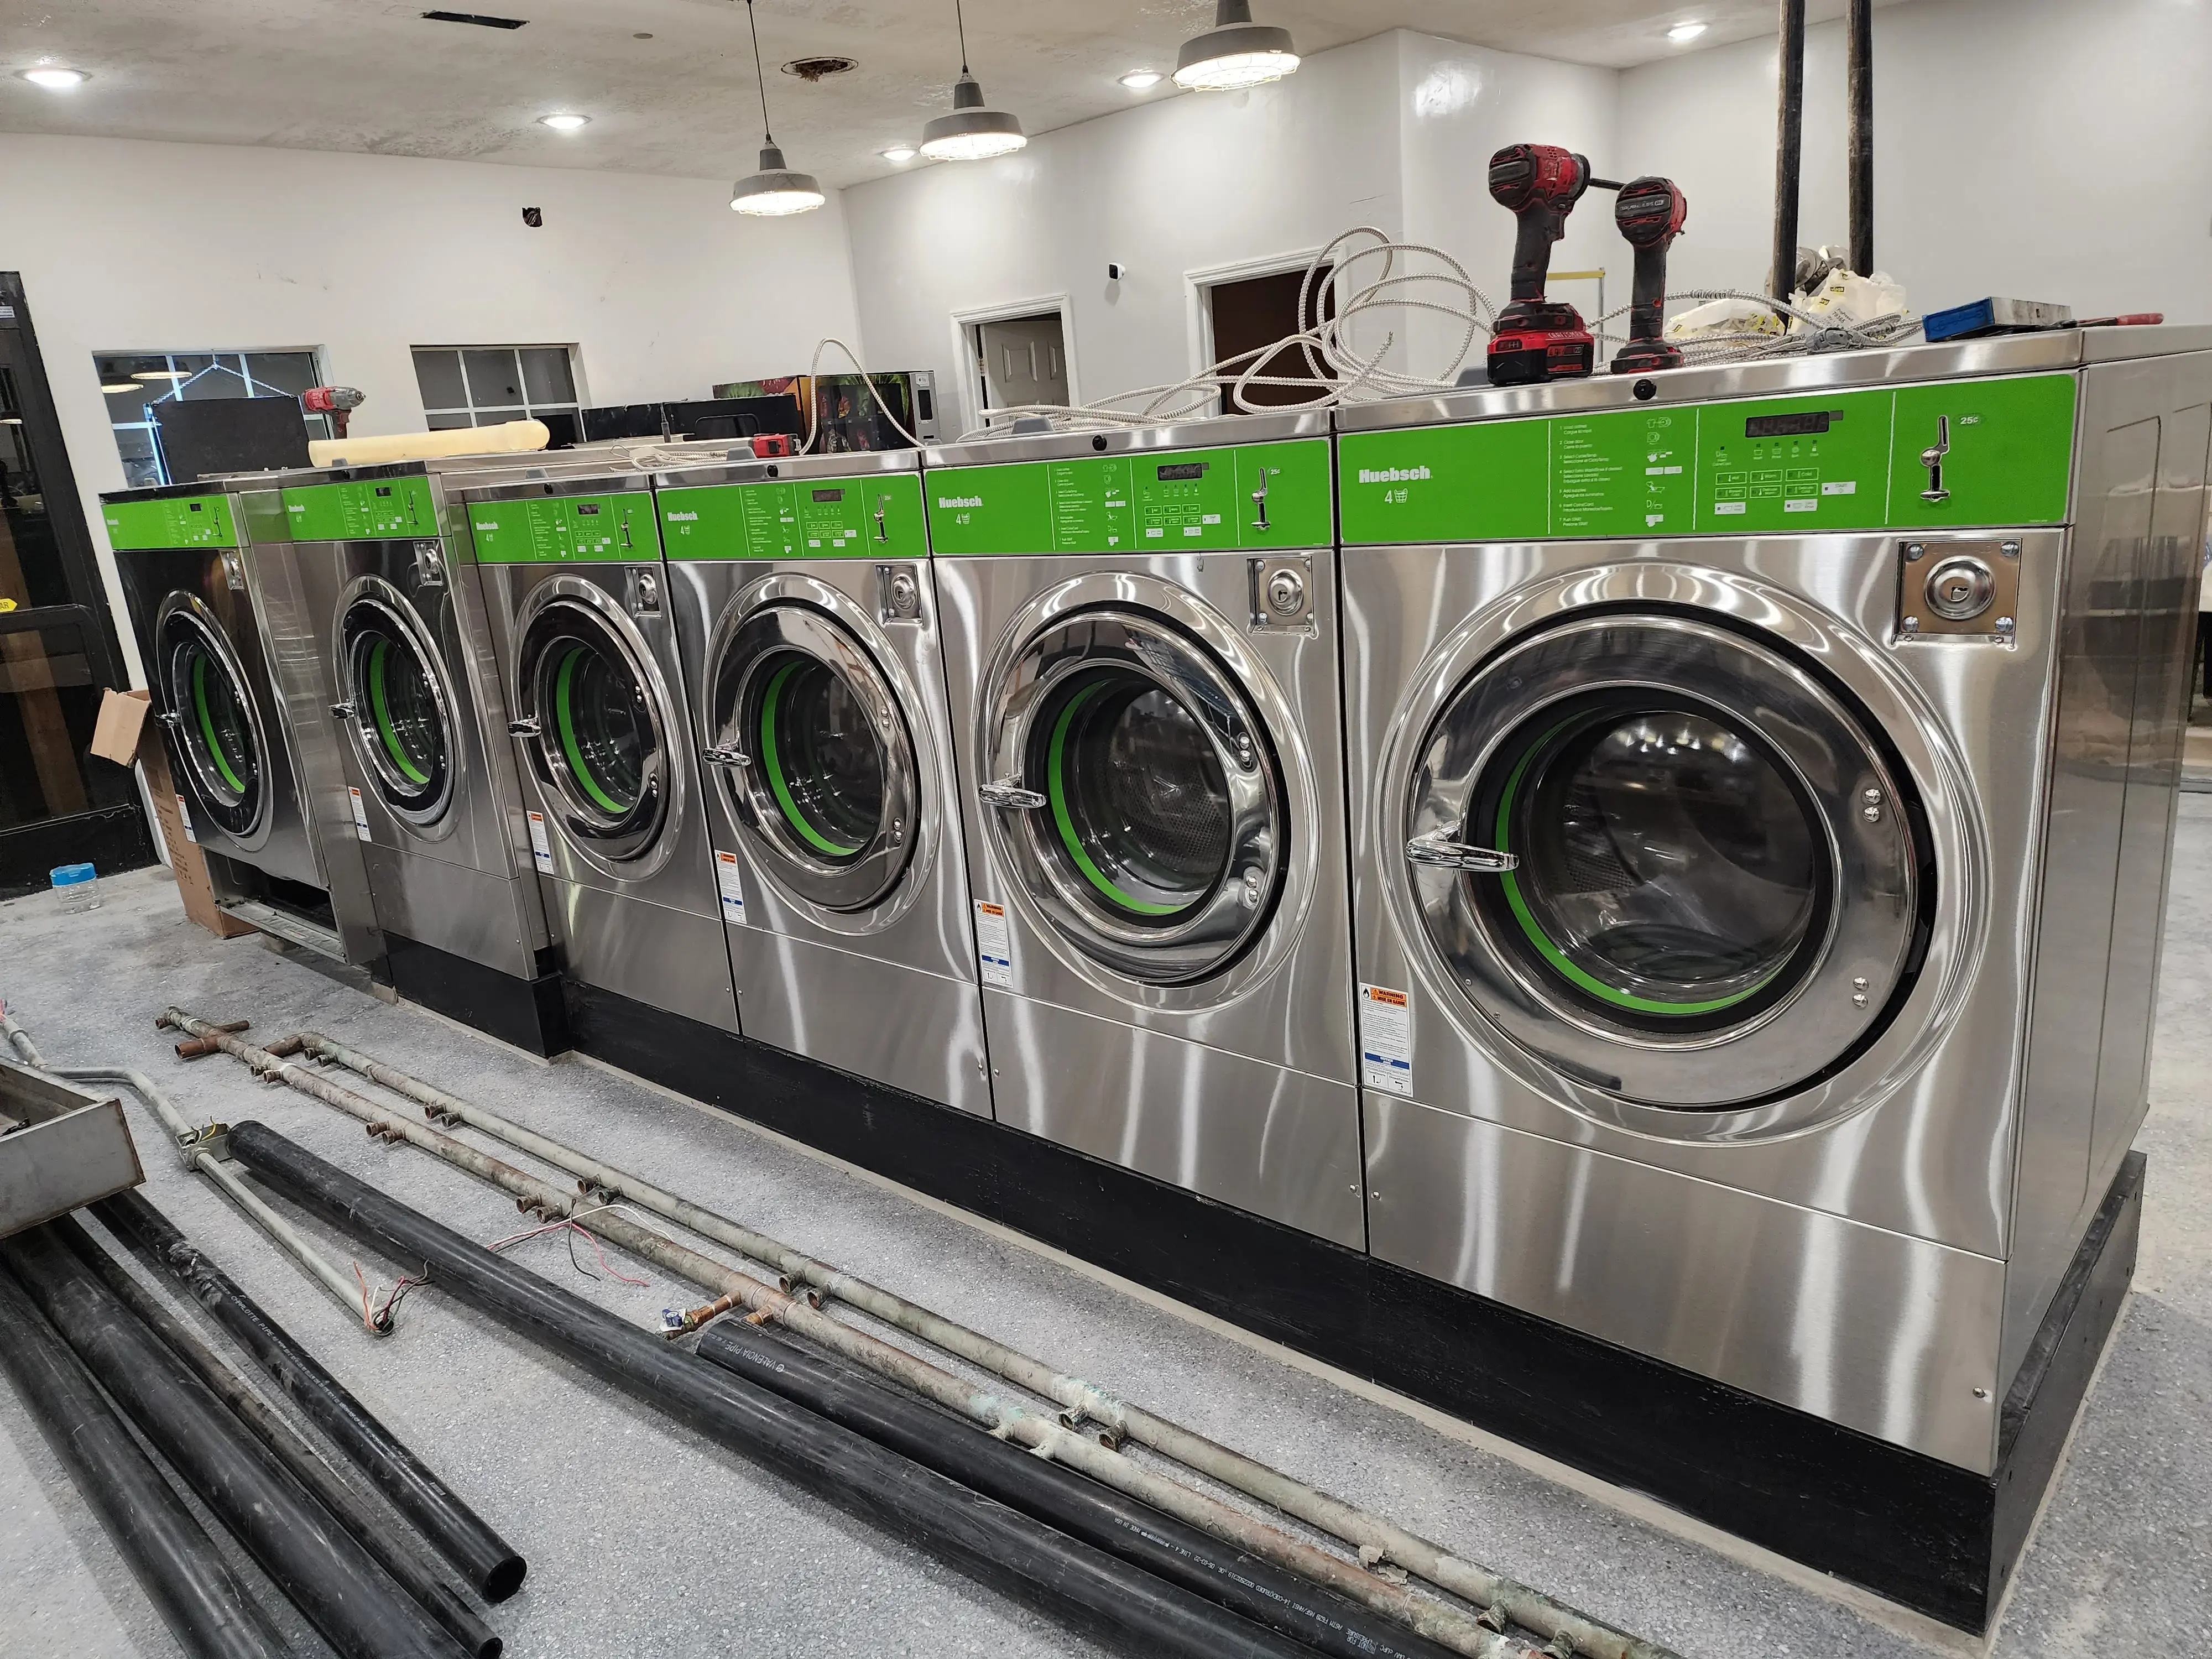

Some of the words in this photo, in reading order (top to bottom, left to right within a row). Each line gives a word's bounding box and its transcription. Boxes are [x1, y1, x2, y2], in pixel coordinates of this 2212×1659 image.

[1832, 311, 1845, 323] 79365
[1359, 465, 1431, 483] Huebsch
[938, 495, 982, 508] Huebsch
[1384, 490, 1393, 504] 4
[956, 513, 962, 525] 4
[231, 1295, 260, 1323] CHARLOTTE
[258, 1322, 275, 1337] PIPE
[724, 1341, 743, 1355] PIPE
[742, 1348, 777, 1370] VALENCIA
[1114, 1517, 1123, 1525] USA
[1292, 1602, 1316, 1618] NSF/ANSI
[1316, 1614, 1328, 1624] F628
[1329, 1618, 1343, 1631] ASTM
